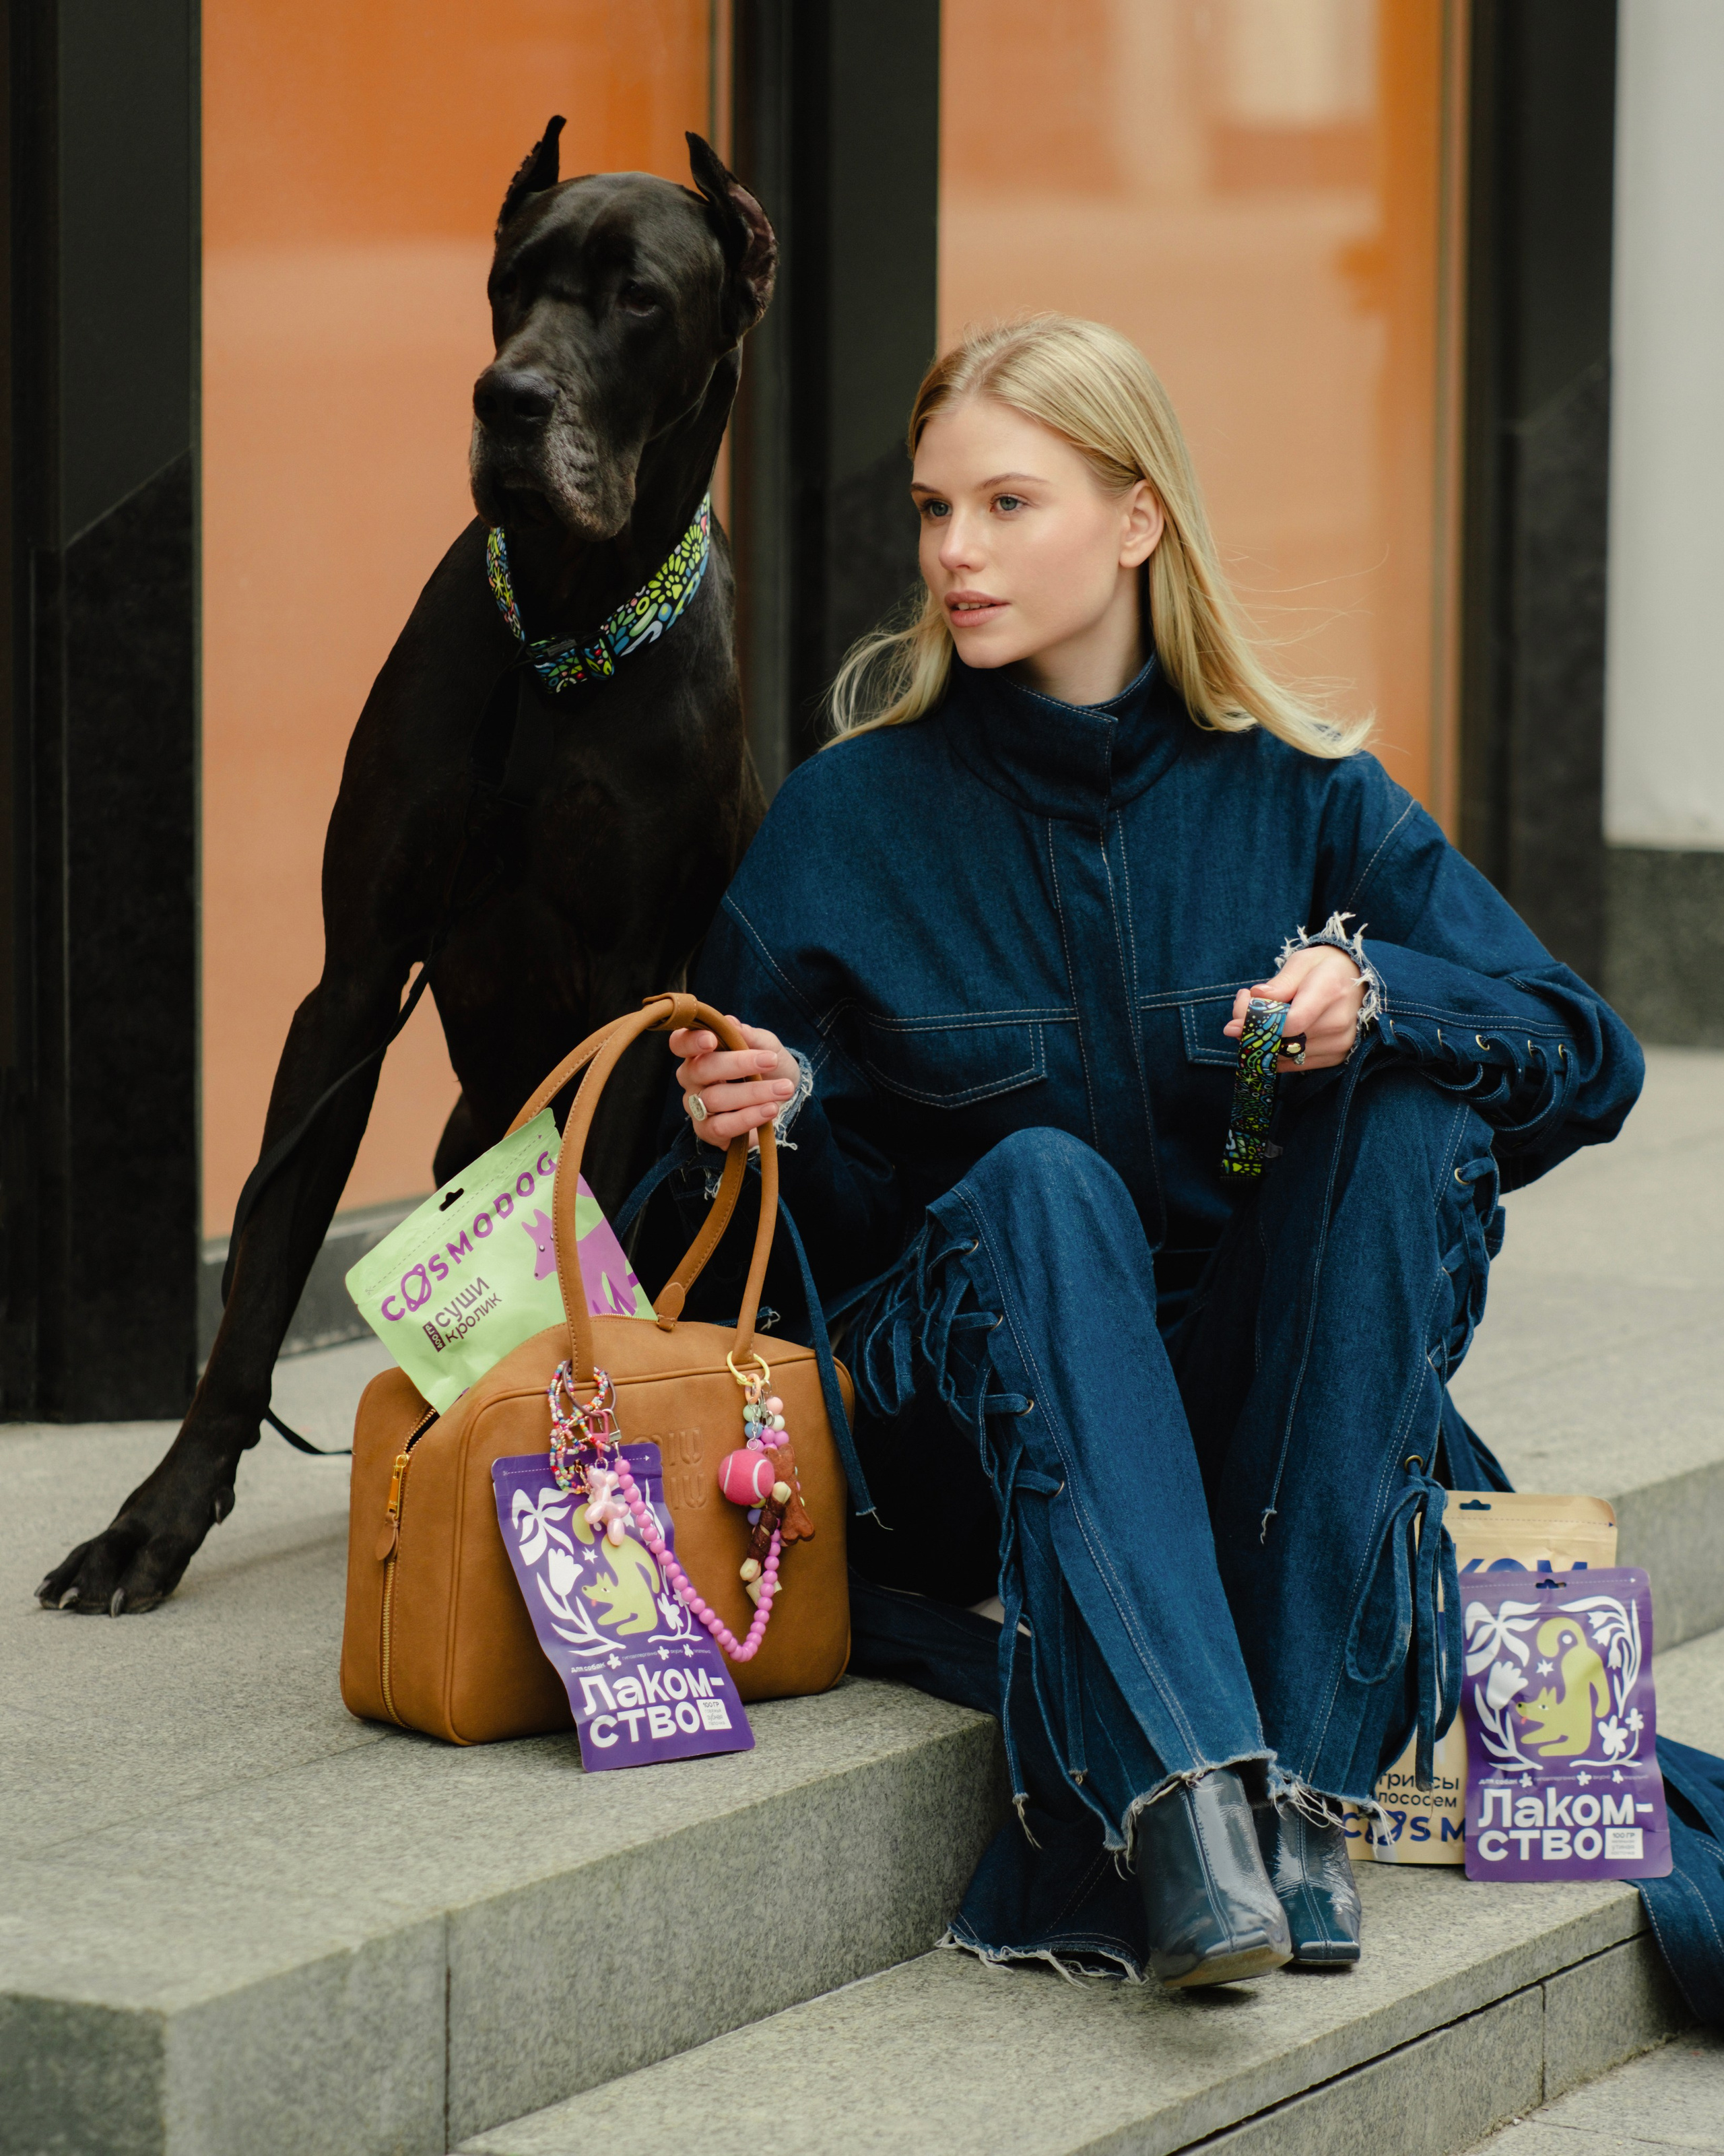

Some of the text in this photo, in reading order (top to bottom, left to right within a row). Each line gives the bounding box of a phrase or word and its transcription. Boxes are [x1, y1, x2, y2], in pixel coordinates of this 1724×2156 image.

[381, 1150, 556, 1321] COSMODOG
[435, 1277, 490, 1327] суши
[445, 1293, 502, 1344] кролик
[670, 1473, 707, 1510] IU
[578, 1664, 725, 1716] Лаком-
[1379, 1773, 1459, 1790] рисы
[1379, 1792, 1457, 1808] лососем
[1478, 1787, 1653, 1827] Лаком-
